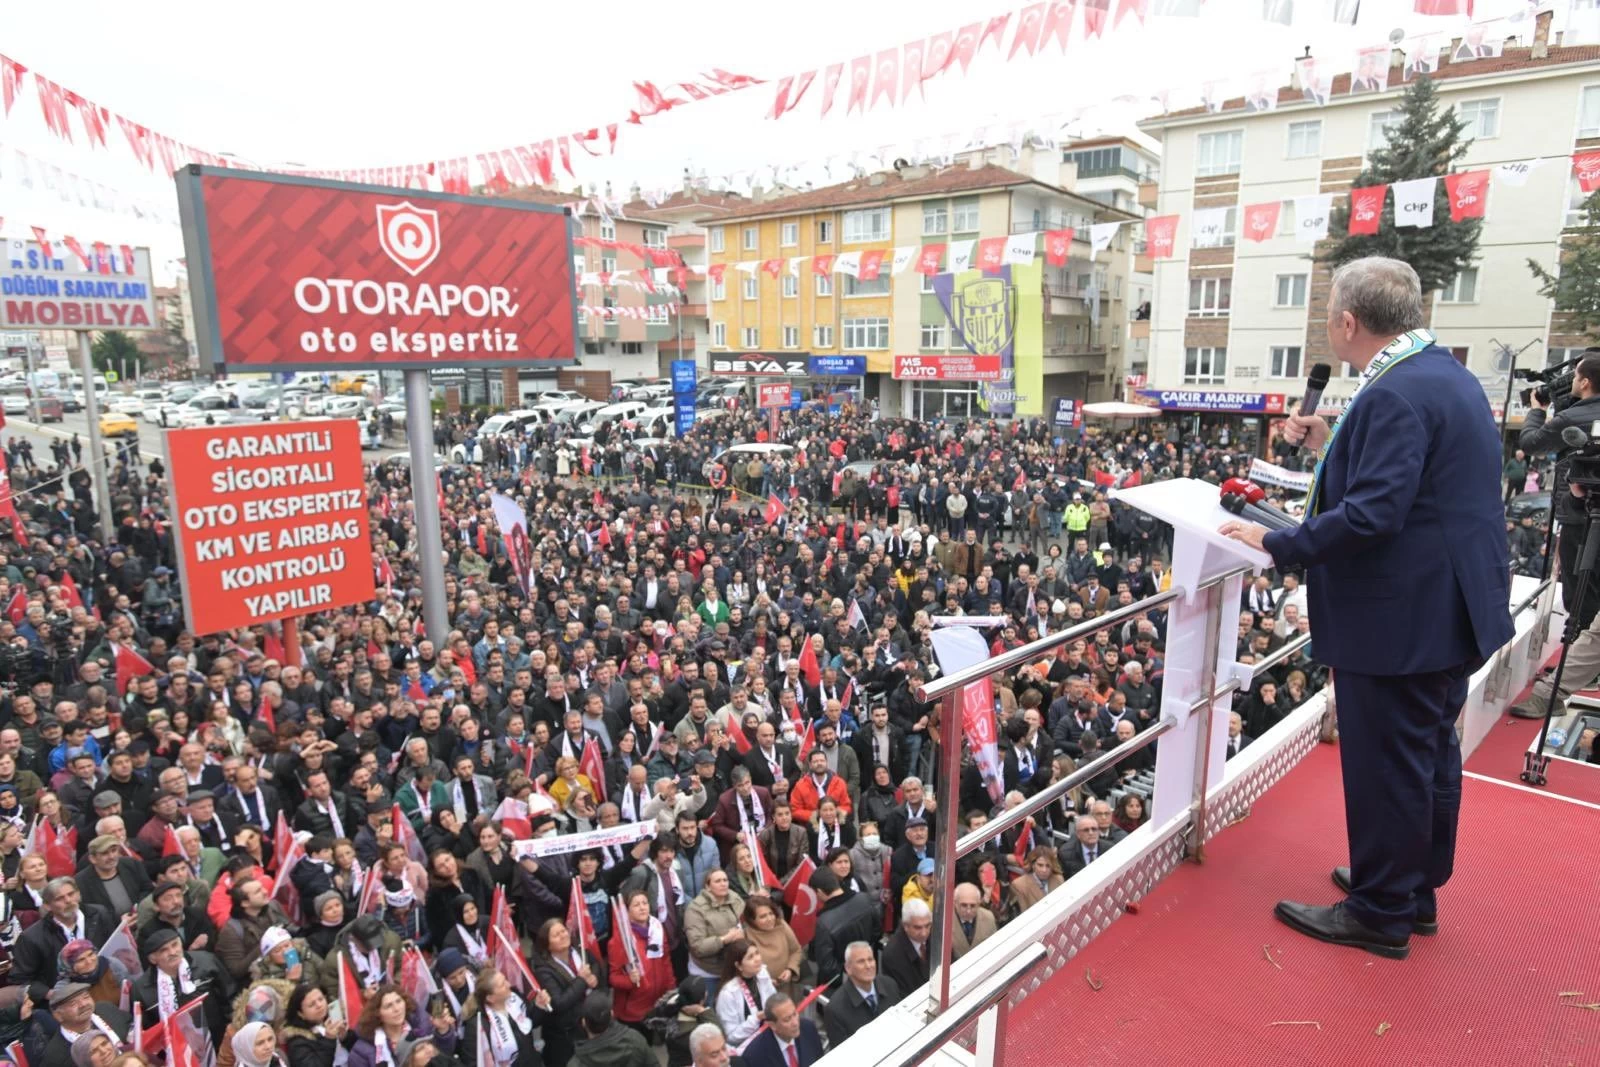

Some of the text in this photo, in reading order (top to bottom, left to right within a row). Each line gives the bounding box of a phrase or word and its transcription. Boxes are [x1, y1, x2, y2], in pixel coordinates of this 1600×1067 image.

[1404, 202, 1428, 213] CHP
[1456, 195, 1477, 208] CHP
[1303, 217, 1324, 228] CHP
[1355, 211, 1375, 221] CHP
[1154, 238, 1171, 247] CHP
[1, 274, 147, 299] DÜĞÜN SARAYLARI
[294, 277, 520, 318] OTORAPOR
[300, 327, 519, 358] oto ekspertiz
[714, 360, 805, 374] BEYAZ
[900, 358, 921, 366] MS
[901, 366, 937, 376] AUTO
[773, 386, 790, 394] AUTO
[1161, 391, 1262, 404] ÇAKIR MARKET
[211, 462, 334, 494] SİGORTALI
[184, 504, 238, 530] OTO
[195, 519, 360, 562] KM VE AIRBAG
[221, 548, 346, 590] KONTROLÜ
[244, 584, 332, 617] YAPILIR
